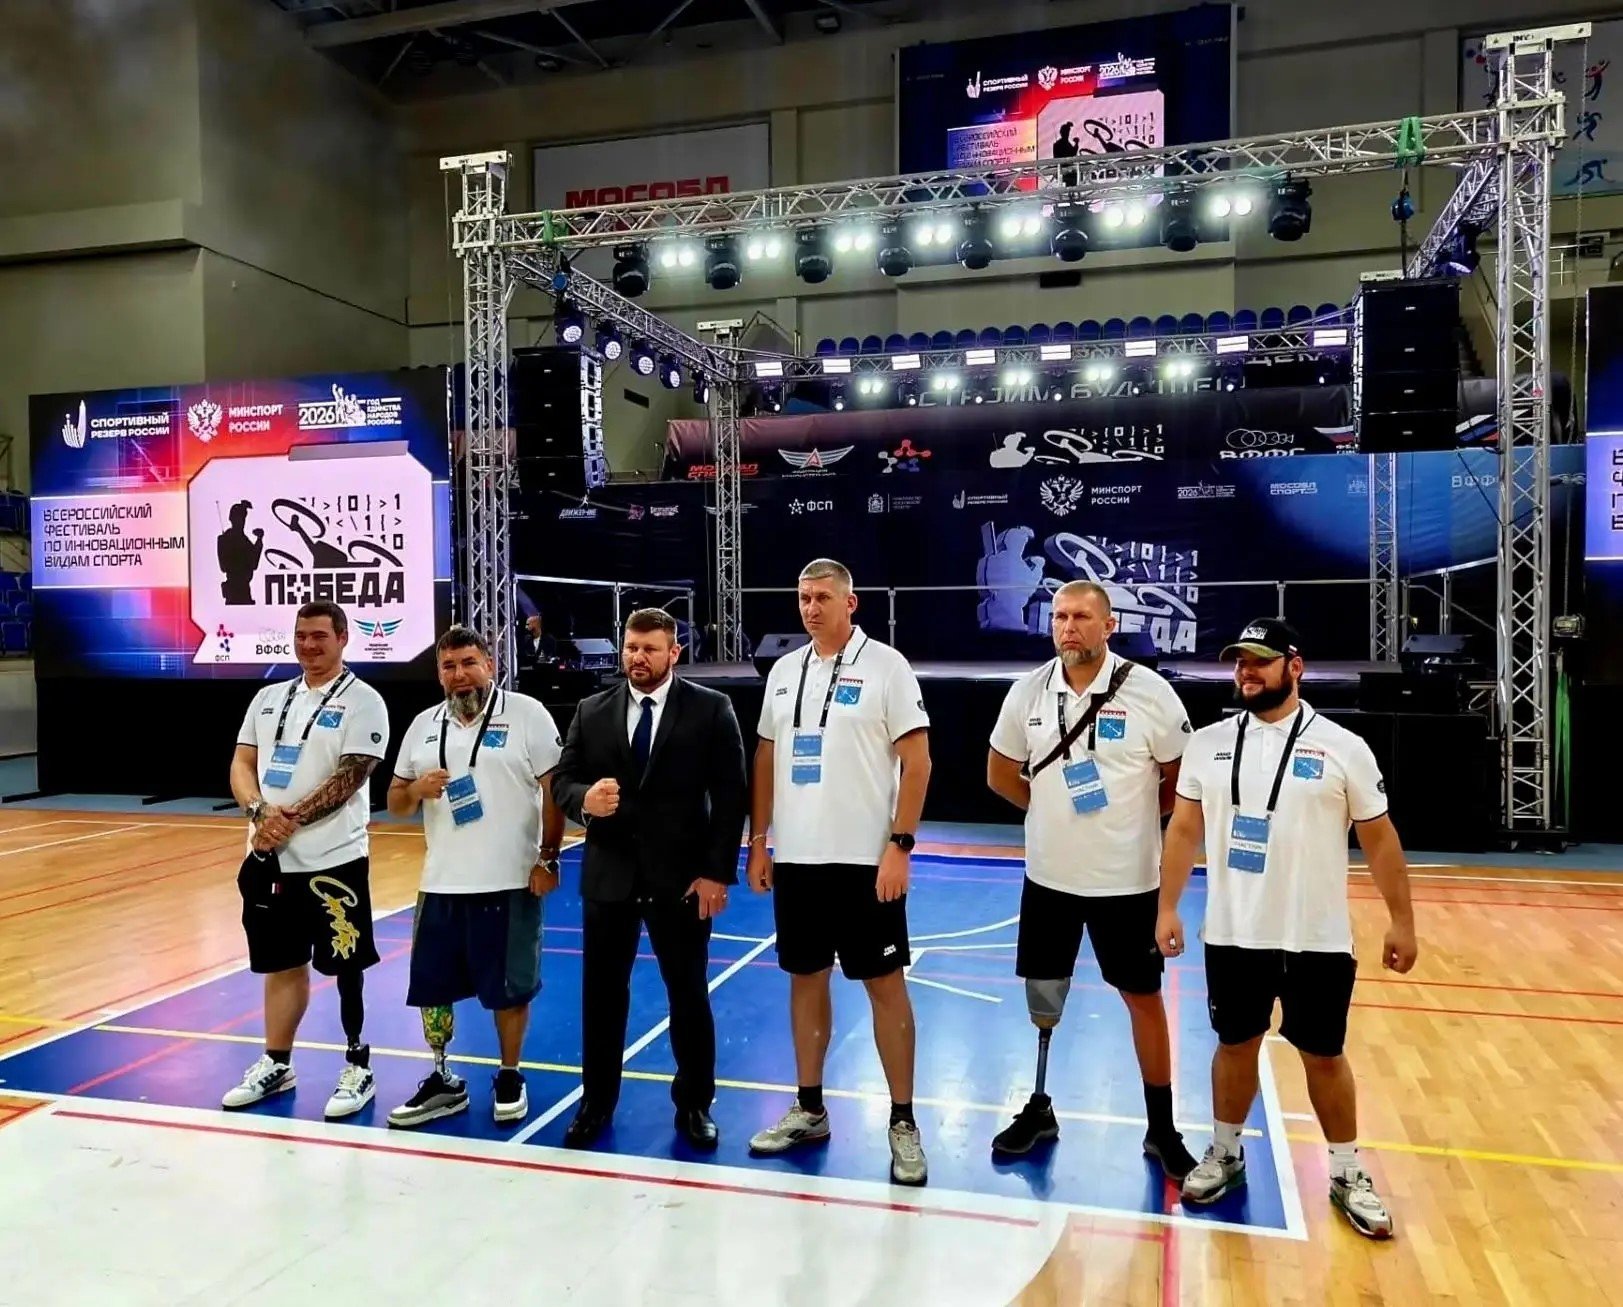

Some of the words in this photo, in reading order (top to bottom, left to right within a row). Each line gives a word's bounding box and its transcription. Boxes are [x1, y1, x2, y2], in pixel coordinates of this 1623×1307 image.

[228, 404, 284, 418] МИНСПОРТ
[299, 407, 335, 425] 2026
[90, 411, 170, 428] СПОРТИВНЫЙ
[228, 420, 271, 433] РОССИИ
[91, 428, 128, 439] РЕЗЕРВ
[128, 426, 170, 437] РОССИИ
[1451, 474, 1500, 488] ВФФ
[1091, 485, 1142, 495] МИНСПОРТ
[806, 500, 833, 512] ФСП
[1091, 496, 1130, 506] РОССИИ
[43, 503, 152, 522] ВСЕРОССИЙСКИЙ
[44, 523, 121, 537] ФЕСТИВАЛЬ
[44, 541, 61, 552] ПО
[65, 536, 185, 552] ИННОВАЦИОННЫМ
[44, 555, 90, 569] ВИДАМ
[93, 553, 143, 568] СПОРТА
[265, 571, 405, 608] ПОБЕДА
[255, 643, 291, 656] ВФФС
[215, 654, 231, 662] ФСП
